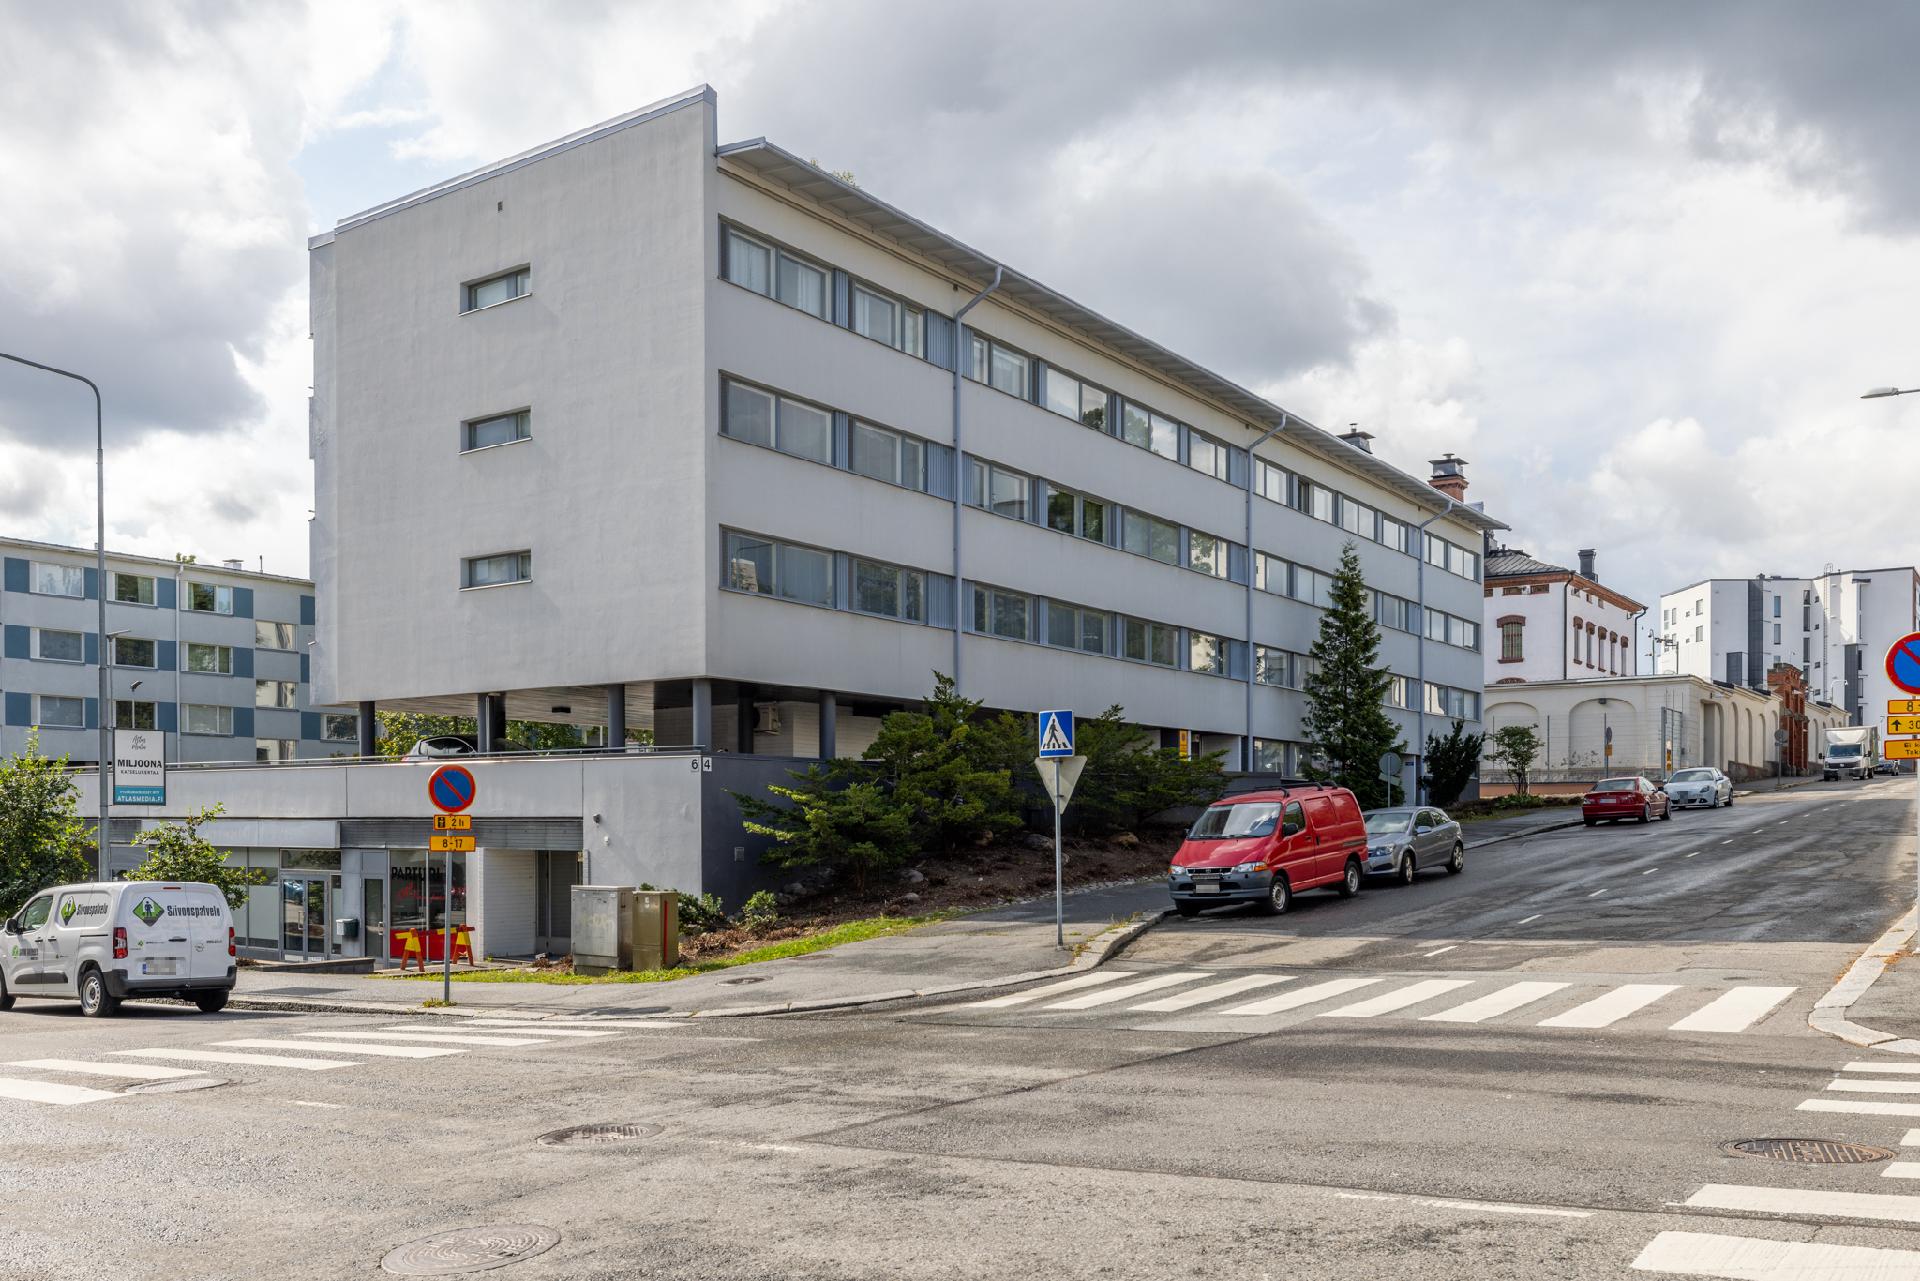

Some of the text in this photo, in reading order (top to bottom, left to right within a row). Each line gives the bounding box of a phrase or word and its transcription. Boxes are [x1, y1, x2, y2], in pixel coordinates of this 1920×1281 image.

[117, 759, 163, 768] MILJOONA
[691, 759, 699, 770] 6
[704, 759, 711, 770] 4
[442, 838, 463, 848] 8-17
